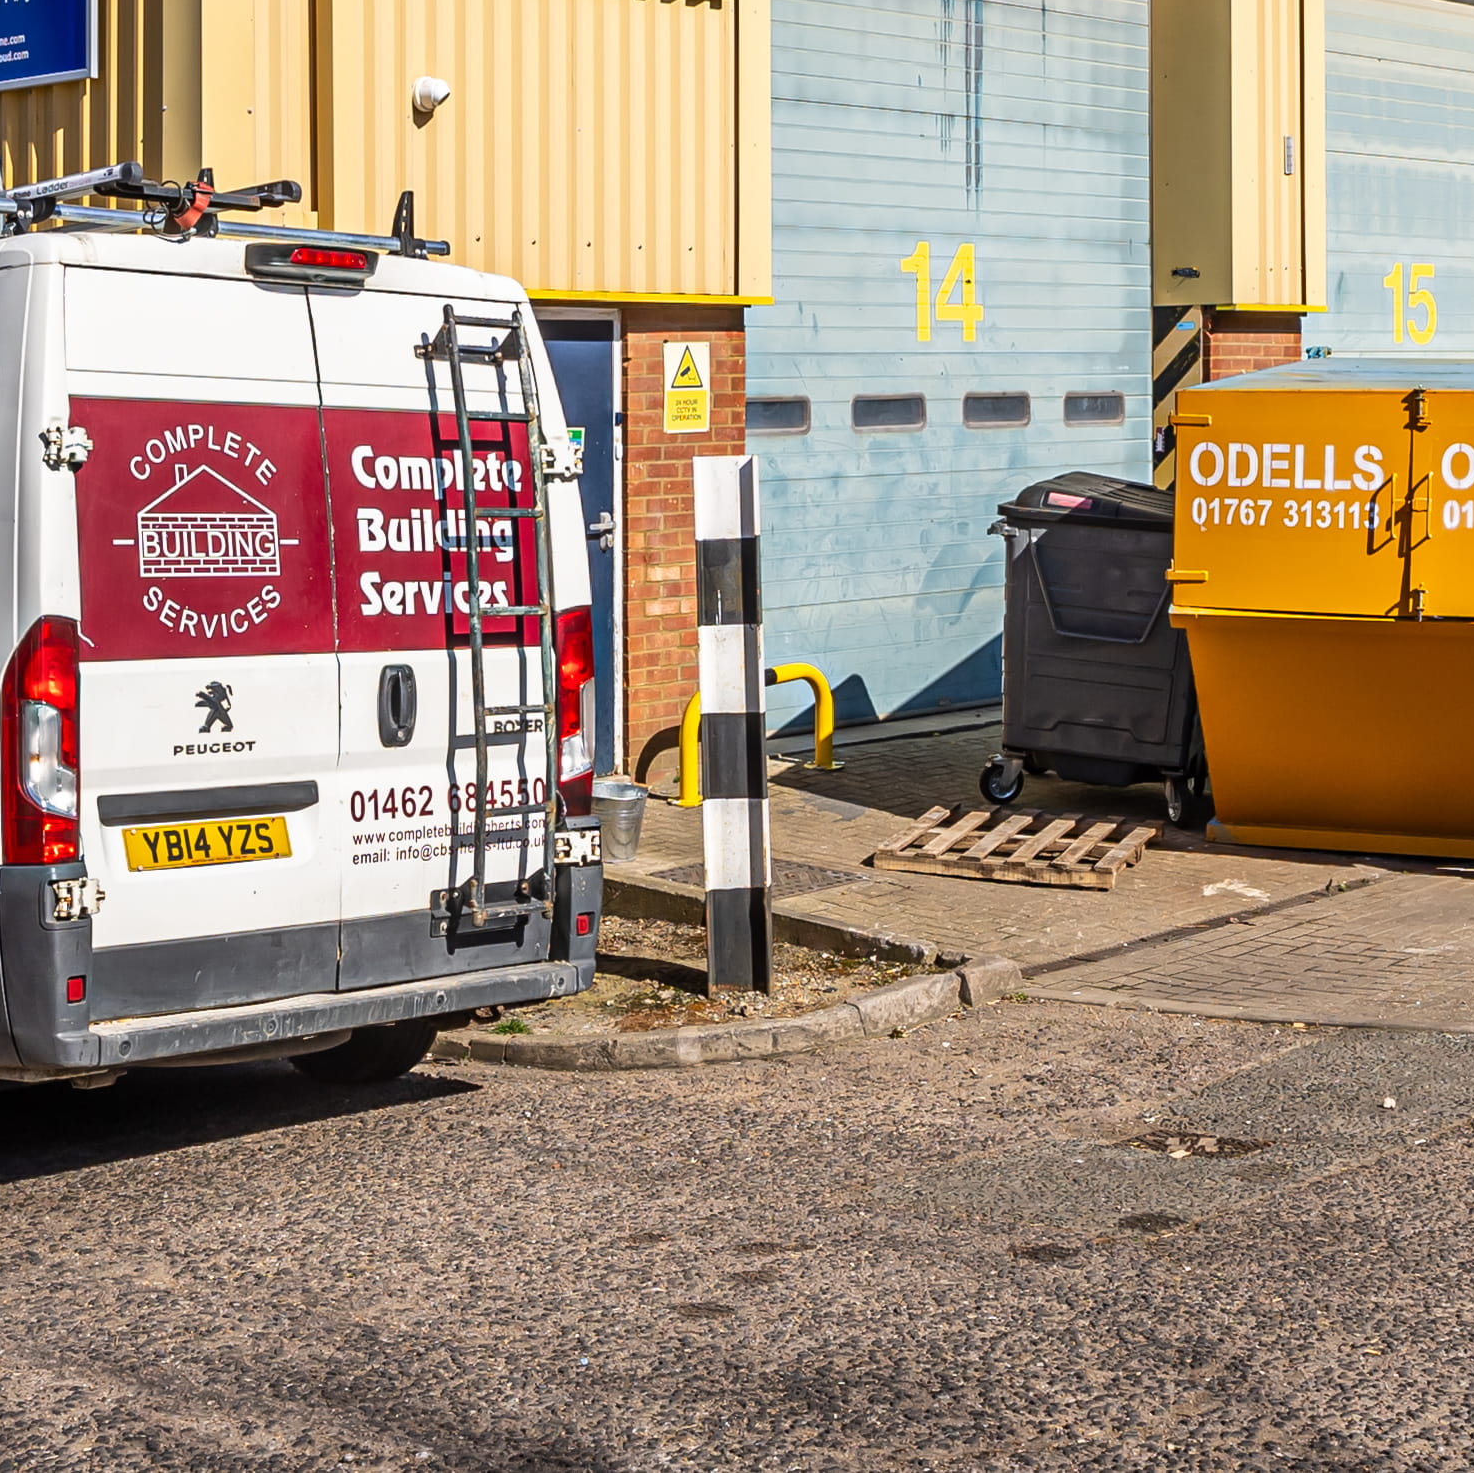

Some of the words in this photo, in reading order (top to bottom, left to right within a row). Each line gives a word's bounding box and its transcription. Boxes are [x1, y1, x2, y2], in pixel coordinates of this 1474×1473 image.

[900, 241, 985, 342] 14
[1383, 262, 1438, 345] 15
[671, 413, 702, 422] OPERATION
[130, 424, 277, 486] COMPLETE
[351, 445, 522, 501] Complete
[1190, 442, 1384, 491] ODELLS
[357, 508, 514, 562] Building
[1191, 497, 1273, 526] 01767
[1283, 499, 1380, 529] 313113
[142, 531, 275, 557] BUILDING
[143, 585, 281, 638] SERVICES
[360, 571, 510, 616] Services
[173, 741, 256, 757] PEUGEOT
[350, 786, 434, 822] 01462
[447, 777, 547, 813] 684550
[142, 827, 211, 864] YB14
[218, 823, 274, 856] YZS
[352, 848, 390, 865] email:
